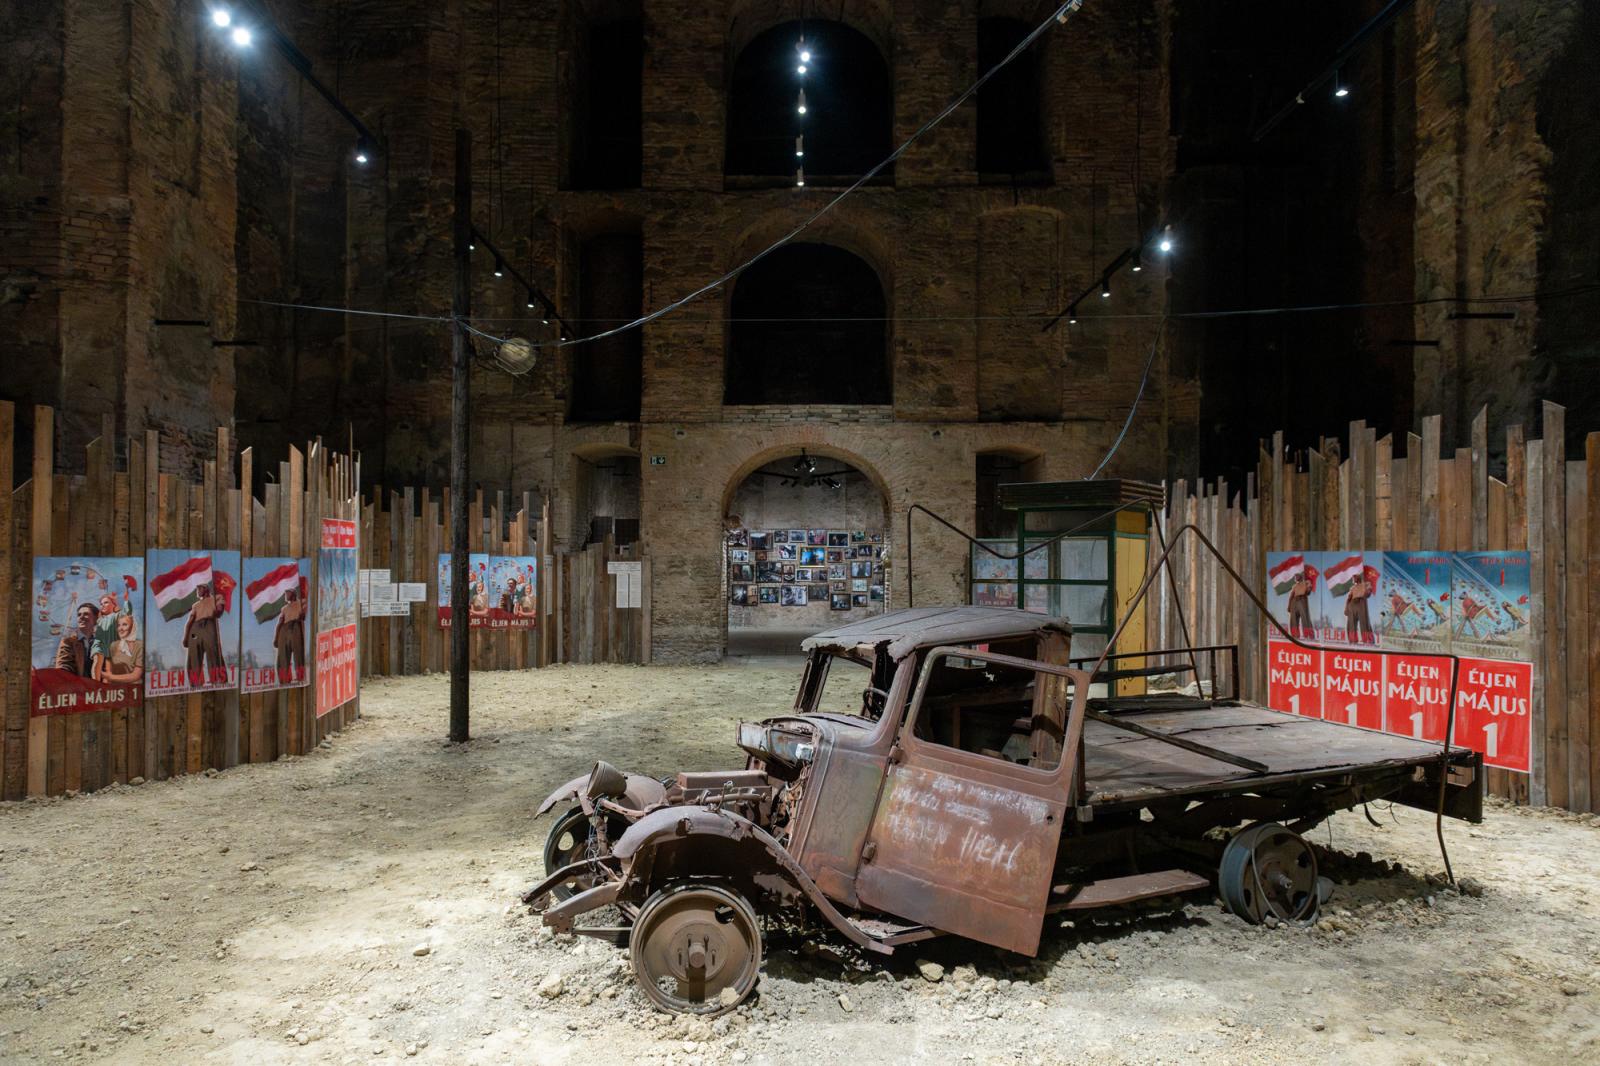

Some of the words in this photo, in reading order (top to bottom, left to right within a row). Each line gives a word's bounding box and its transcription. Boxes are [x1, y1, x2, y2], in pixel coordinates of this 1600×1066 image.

[491, 618, 509, 627] ÉLJEN
[511, 618, 529, 626] MÁJUS
[1278, 649, 1311, 666] ÉLJEN
[1334, 654, 1371, 672] ÉLJEN
[150, 665, 185, 689] ÉLJEN
[229, 663, 236, 684] 1
[246, 664, 275, 687] ÉLJEN
[1271, 667, 1319, 689] MÁJUS
[1397, 661, 1439, 680] ÉLJEN
[1469, 668, 1517, 689] ÉLJEN
[1326, 674, 1379, 697] MÁJUS
[1388, 681, 1448, 706] MÁJUS
[38, 691, 77, 710] ÉLJEN
[85, 687, 125, 704] MÁJUS
[132, 690, 138, 701] 1
[1288, 694, 1300, 716] 1
[1458, 689, 1527, 716] MÁJUS
[1345, 702, 1358, 727] 1
[1409, 711, 1423, 739] 1
[1482, 722, 1498, 758] 1
